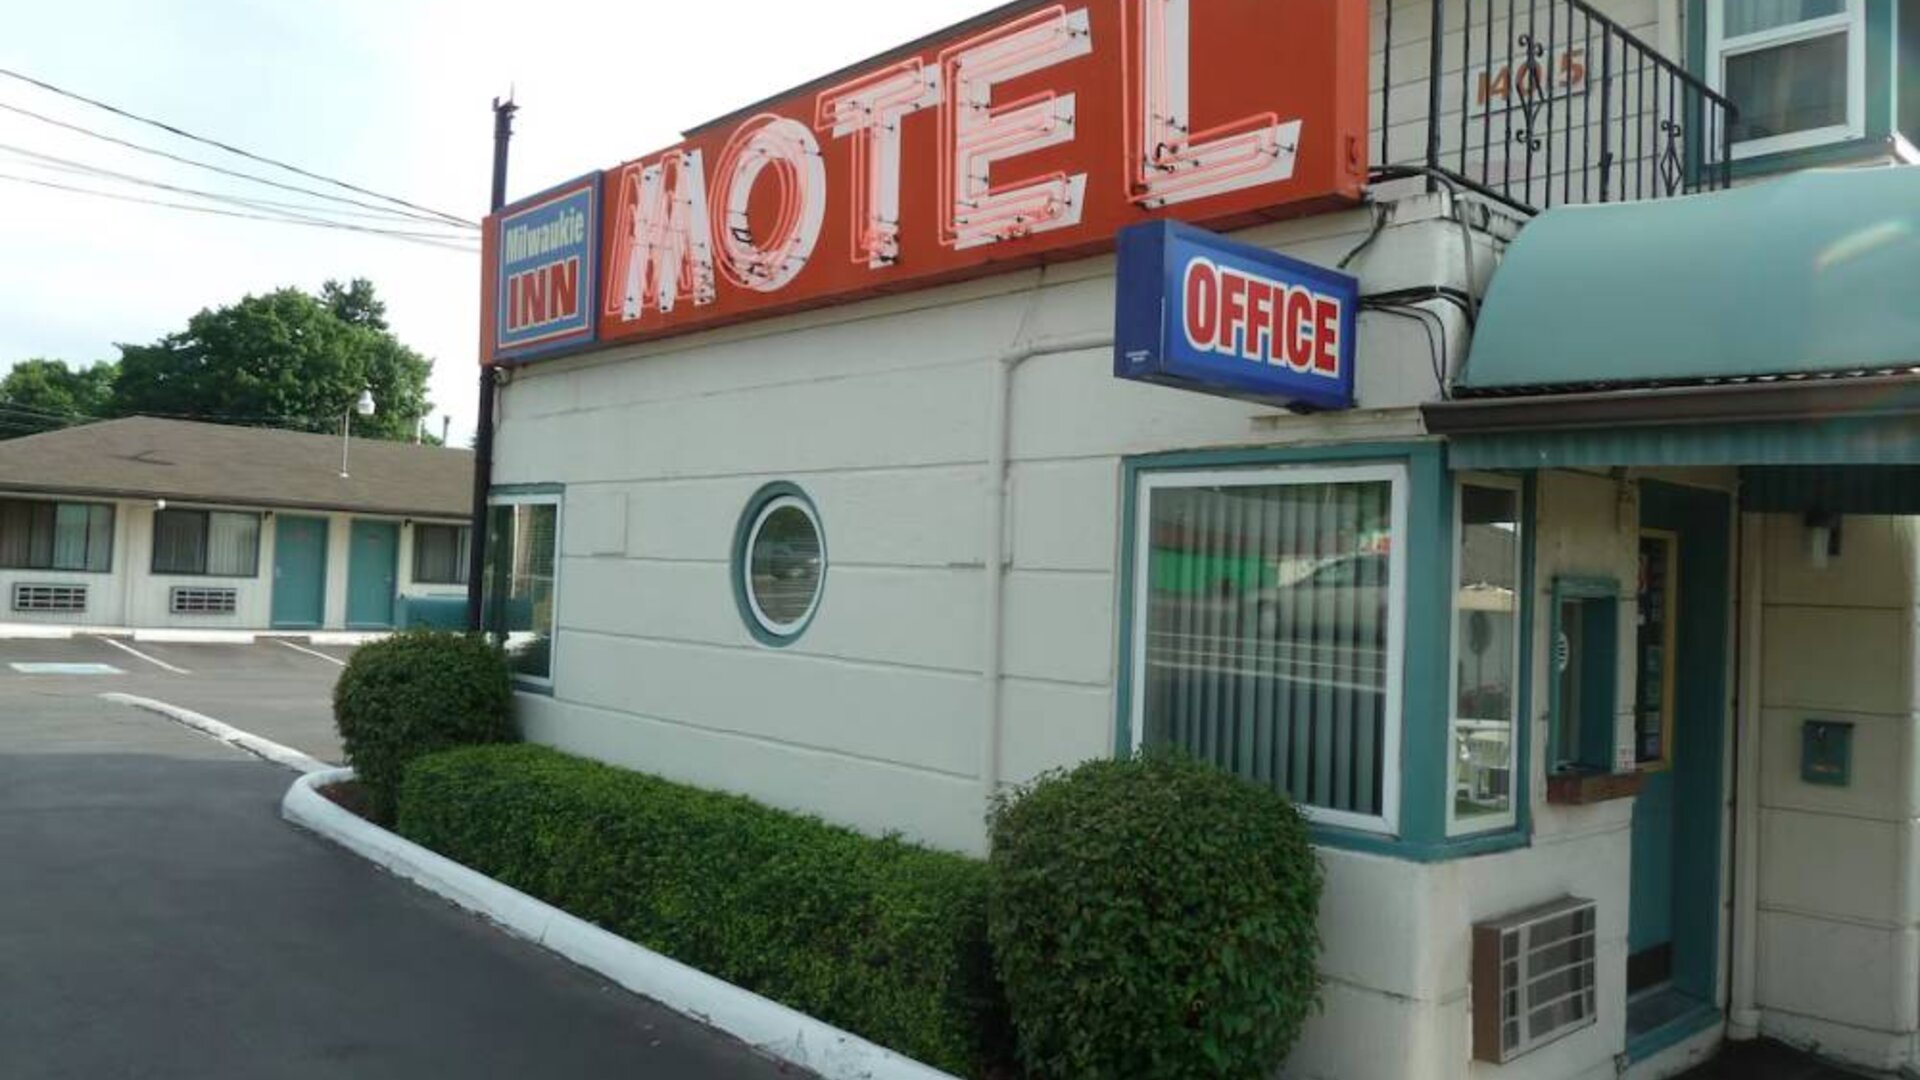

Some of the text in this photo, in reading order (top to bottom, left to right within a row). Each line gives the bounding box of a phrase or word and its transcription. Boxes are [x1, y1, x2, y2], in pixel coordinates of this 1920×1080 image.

[605, 0, 1302, 321] MOTEL
[506, 207, 584, 264] Milwaukie
[508, 256, 579, 331] INN
[1183, 256, 1341, 379] OFFICE
